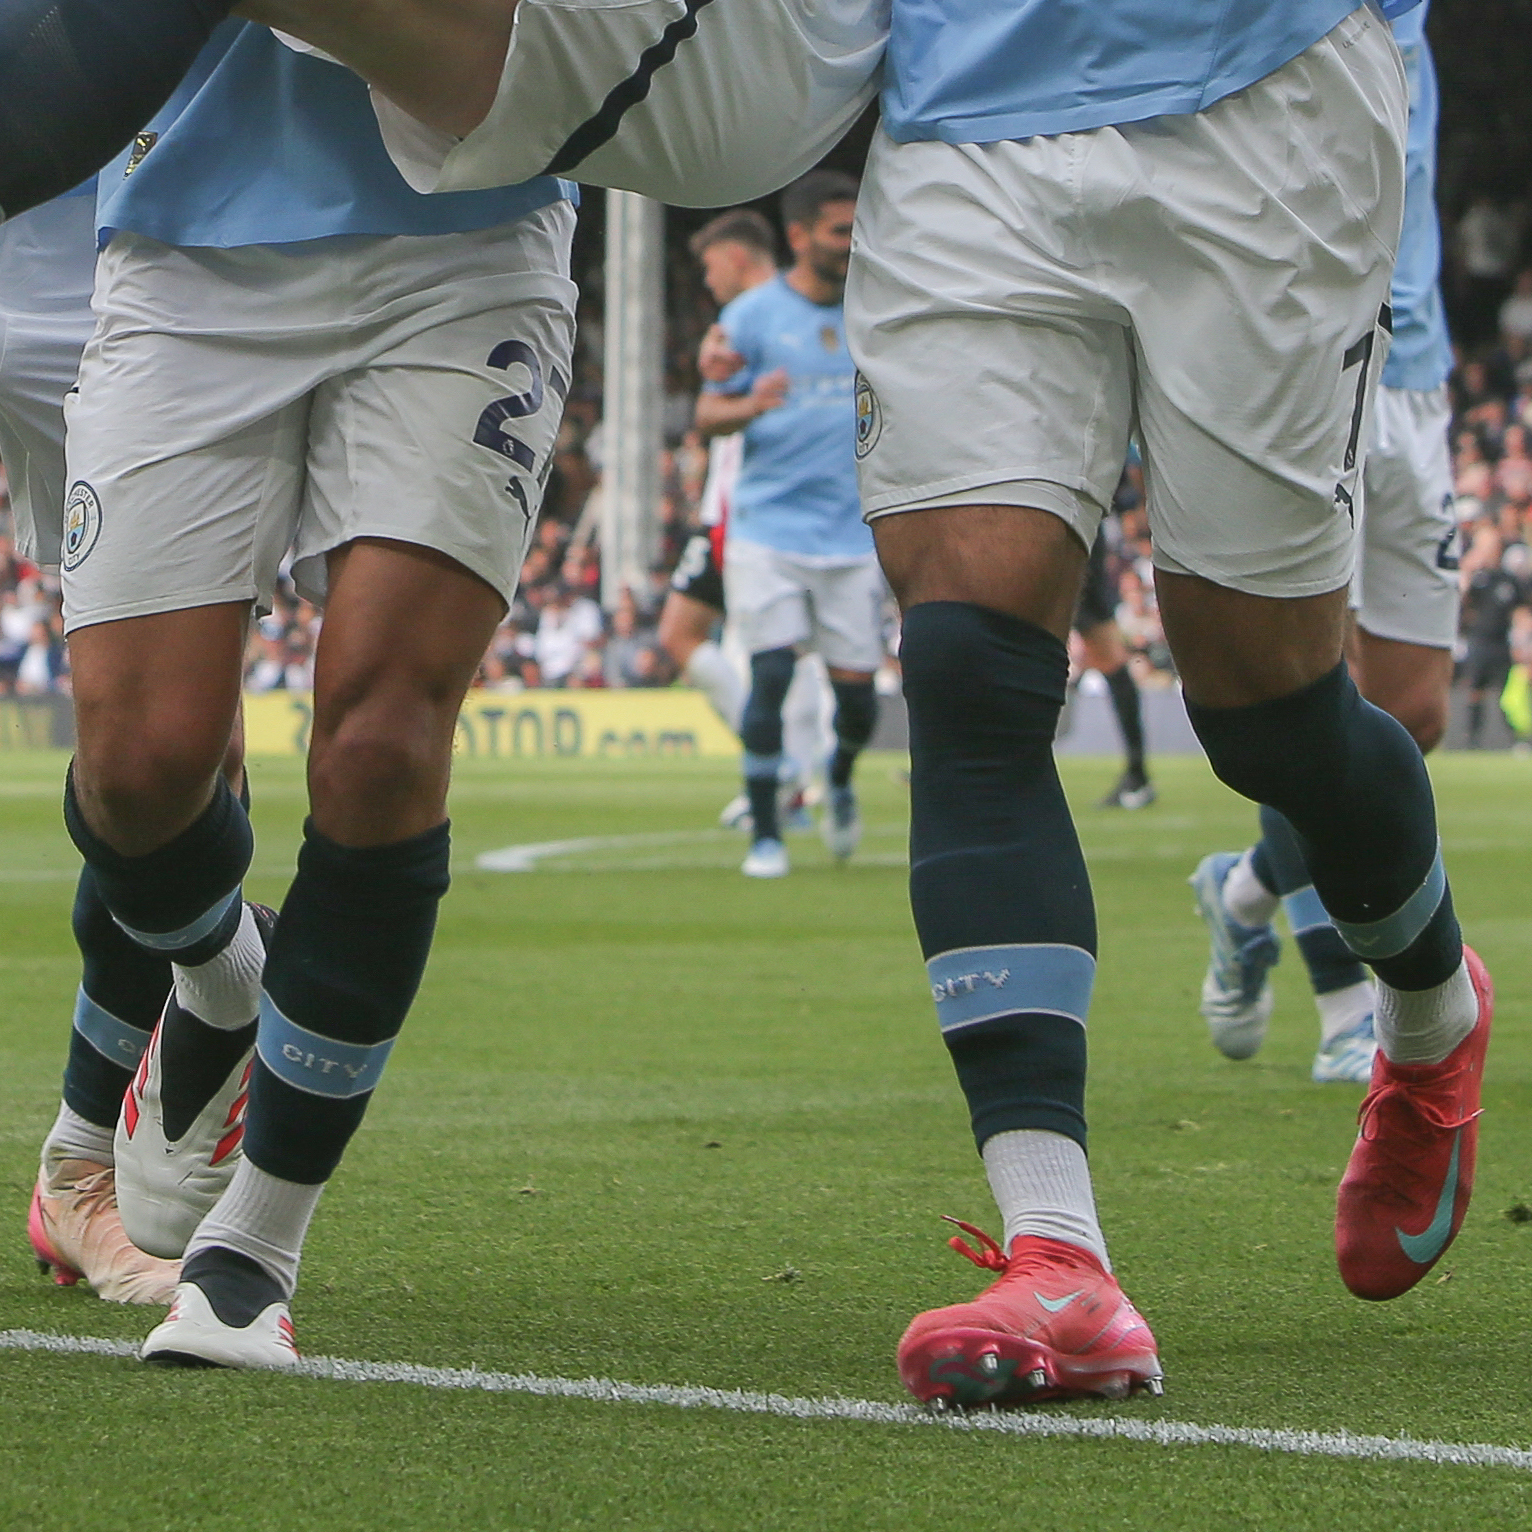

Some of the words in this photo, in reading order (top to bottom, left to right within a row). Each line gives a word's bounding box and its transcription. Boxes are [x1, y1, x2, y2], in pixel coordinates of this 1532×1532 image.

[473, 339, 568, 474] 2
[932, 968, 1011, 1002] CITY
[282, 1042, 368, 1080] CITY
